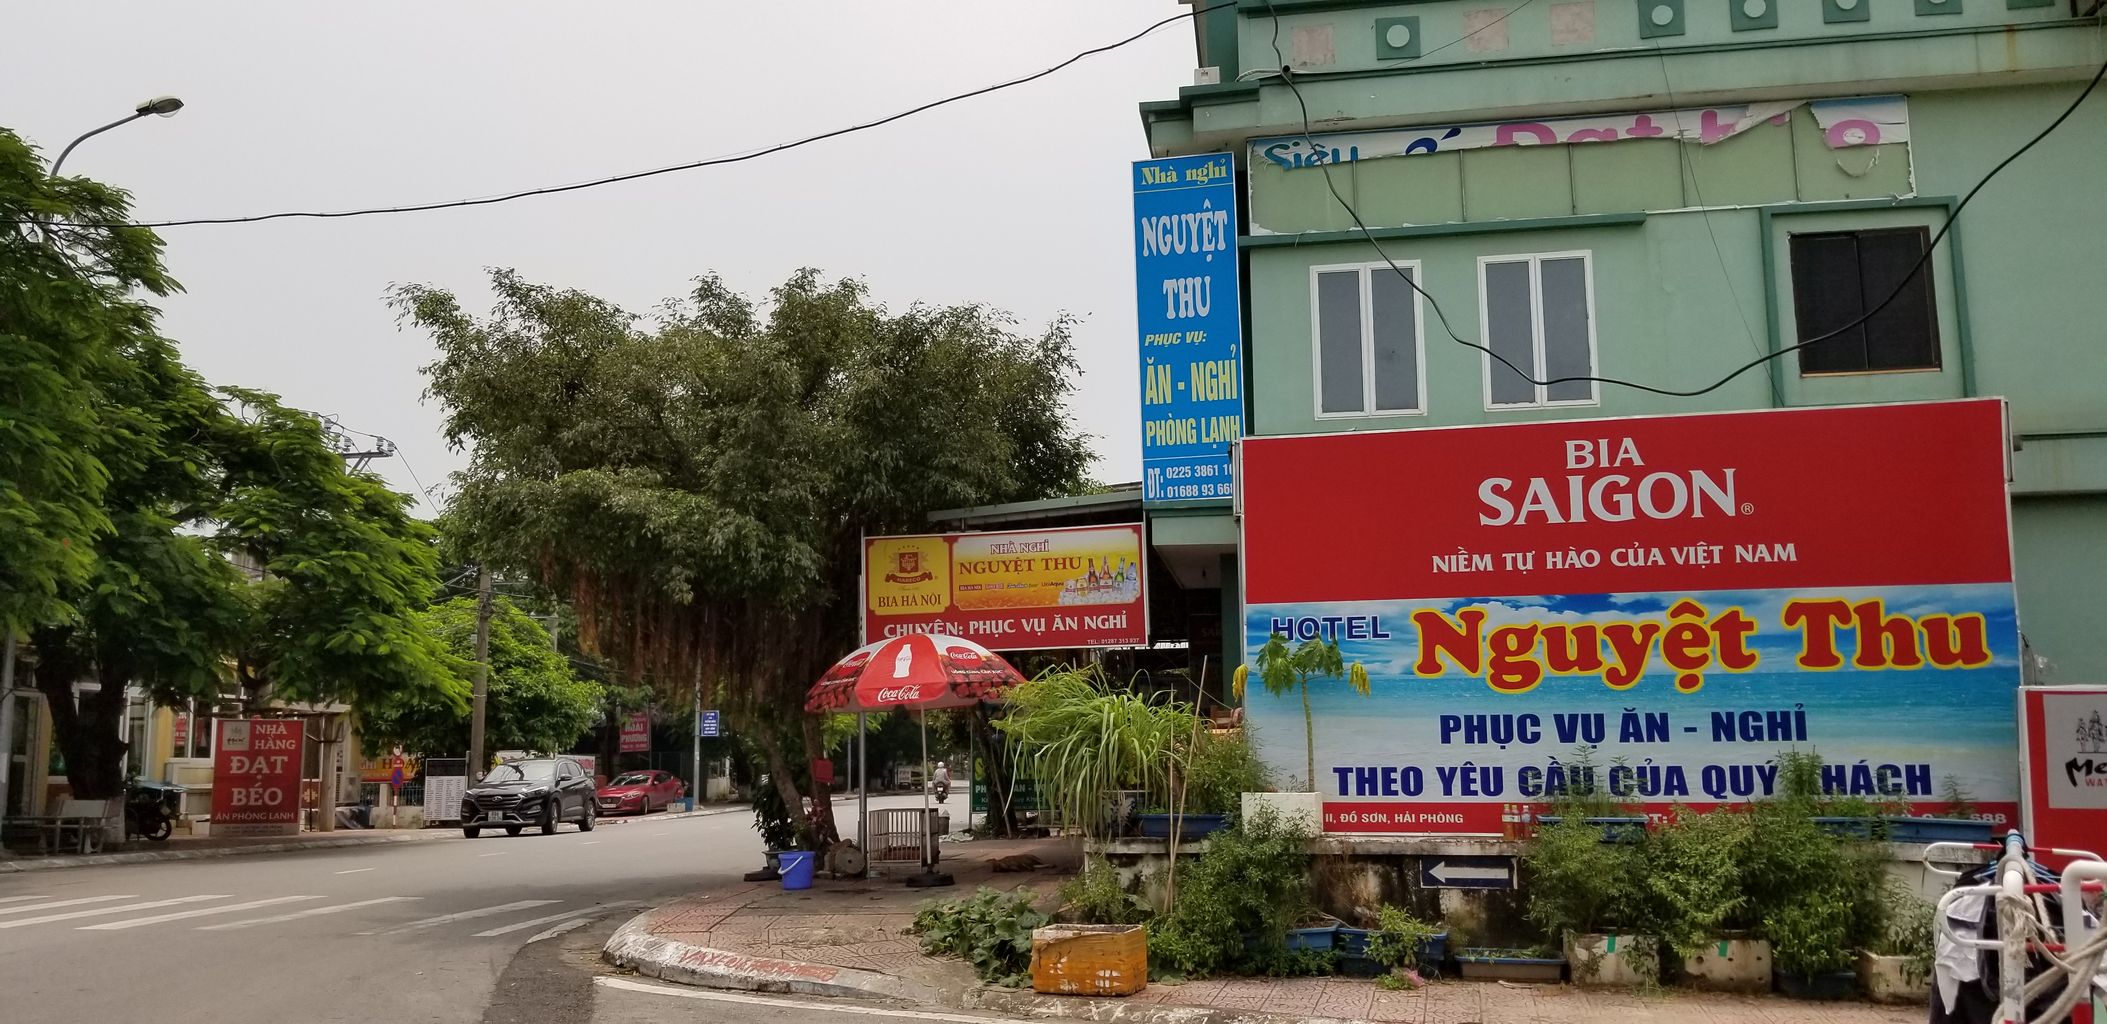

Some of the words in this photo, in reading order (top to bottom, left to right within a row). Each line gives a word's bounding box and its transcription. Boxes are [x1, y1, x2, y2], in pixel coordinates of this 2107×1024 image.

[1141, 165, 1178, 185] Nhà
[1185, 158, 1227, 185] nghỉ
[1141, 198, 1228, 262] NGUYỆT
[1163, 276, 1211, 319] THU
[1144, 332, 1182, 347] PHỤC
[1185, 330, 1207, 345] VỤ:
[1145, 356, 1172, 405] ĂN
[1177, 381, 1185, 390] -
[1190, 344, 1238, 402] NGHỈ
[1145, 413, 1197, 447] PHÒNG
[1201, 415, 1240, 449] LẠNH
[1565, 437, 1645, 469] BIA
[1166, 466, 1192, 479] 0225
[1194, 464, 1219, 477] 3861
[1167, 485, 1199, 499] 01688
[1201, 484, 1215, 496] 93
[1478, 468, 1736, 526] SAIGON
[990, 540, 1018, 555] NHÀ
[1019, 538, 1050, 553] NGHỈ
[1432, 546, 1494, 573] NIỀM
[1502, 550, 1535, 575] TỰ
[1546, 546, 1600, 569] HÀO
[1610, 541, 1666, 567] CỦA
[1670, 541, 1723, 569] VIỆT
[1735, 543, 1798, 563] NAM
[959, 556, 1036, 575] NGUYỆT
[1041, 556, 1081, 570] THU
[878, 595, 899, 608] BIA
[883, 619, 964, 638] CHUYÊN:
[969, 618, 1016, 638] PHỤC
[1022, 617, 1046, 635] VỤ
[1052, 614, 1079, 632] ĂN
[1084, 610, 1128, 630] NGHỈ
[1271, 615, 1391, 641] HOTEL
[1410, 598, 1758, 693] Nguyệt
[1782, 597, 1993, 671] Thu
[255, 722, 287, 737] NHÀ
[1439, 713, 1541, 749] PHỤC
[1553, 713, 1606, 749] VỤ
[1619, 707, 1670, 743] ĂN
[1711, 702, 1808, 742] NGHỈ
[254, 738, 296, 750] HÀNG
[229, 755, 288, 780] ĐẠT
[1333, 766, 1423, 796] THEO
[1436, 760, 1504, 796] YÊU
[1608, 758, 1689, 797] CỦA
[1701, 759, 1779, 800] QUÝ
[1820, 759, 1932, 797] HÁCH
[230, 782, 283, 806] BÉO
[1361, 811, 1391, 824] SƠN,
[1395, 810, 1416, 823] HẢI
[1419, 810, 1464, 823] PHÒNG
